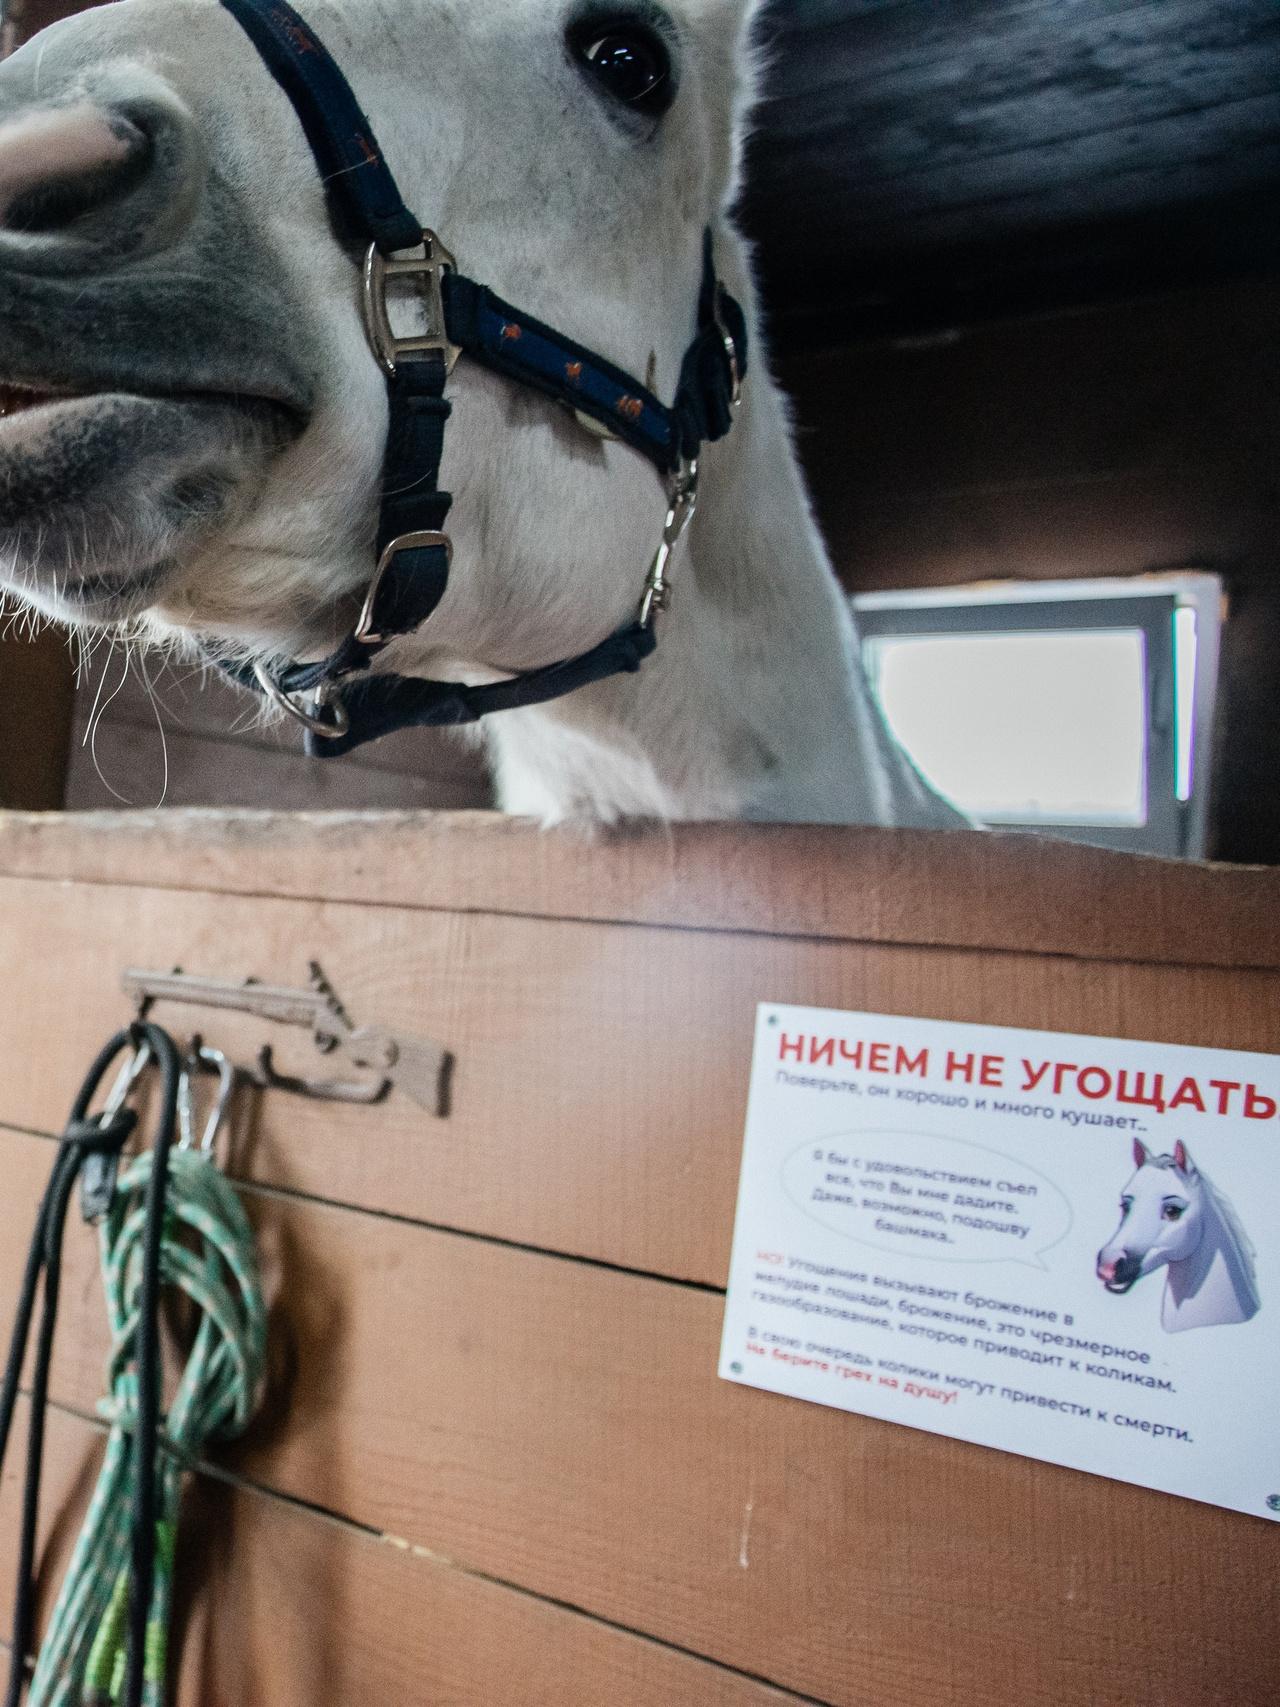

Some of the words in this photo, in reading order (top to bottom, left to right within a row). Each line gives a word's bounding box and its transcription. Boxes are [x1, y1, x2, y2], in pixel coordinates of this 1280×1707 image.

[776, 1070, 863, 1097] Поверьте,
[867, 1083, 891, 1098] он
[895, 1087, 970, 1109] хорошо
[974, 1097, 988, 1111] и
[992, 1099, 1056, 1121] много
[778, 1032, 930, 1078] НИЧЕМ
[944, 1050, 1006, 1088] НЕ
[1021, 1058, 1280, 1121] УГОЩАТЬ
[827, 1151, 849, 1166] бы
[852, 1158, 861, 1169] с
[864, 1160, 992, 1188] удовольствием
[995, 1180, 1038, 1197] съел
[859, 1178, 886, 1192] что
[889, 1181, 913, 1196] Вы
[917, 1188, 950, 1202] мне
[861, 1199, 948, 1224] возможно,
[951, 1213, 1030, 1239] подошву
[873, 1275, 959, 1301] вызывают
[963, 1292, 1058, 1322] брожение
[1063, 1313, 1075, 1326] в
[897, 1299, 992, 1333] брожение,
[996, 1321, 1026, 1338] это
[1030, 1328, 1152, 1366] чрезмерное
[898, 1322, 968, 1347] которое
[973, 1337, 1064, 1369] приводит
[1068, 1359, 1081, 1373] к
[1085, 1362, 1177, 1394] коликам.
[772, 1347, 829, 1371] берите
[834, 1364, 873, 1383] грех
[877, 1376, 899, 1390] на
[902, 1381, 959, 1405] душу!
[805, 1341, 874, 1366] очередь
[877, 1359, 940, 1382] колики
[944, 1374, 996, 1397] могут
[1000, 1385, 1091, 1418] привести
[1096, 1408, 1109, 1423] к
[1113, 1413, 1194, 1444] смерти.
